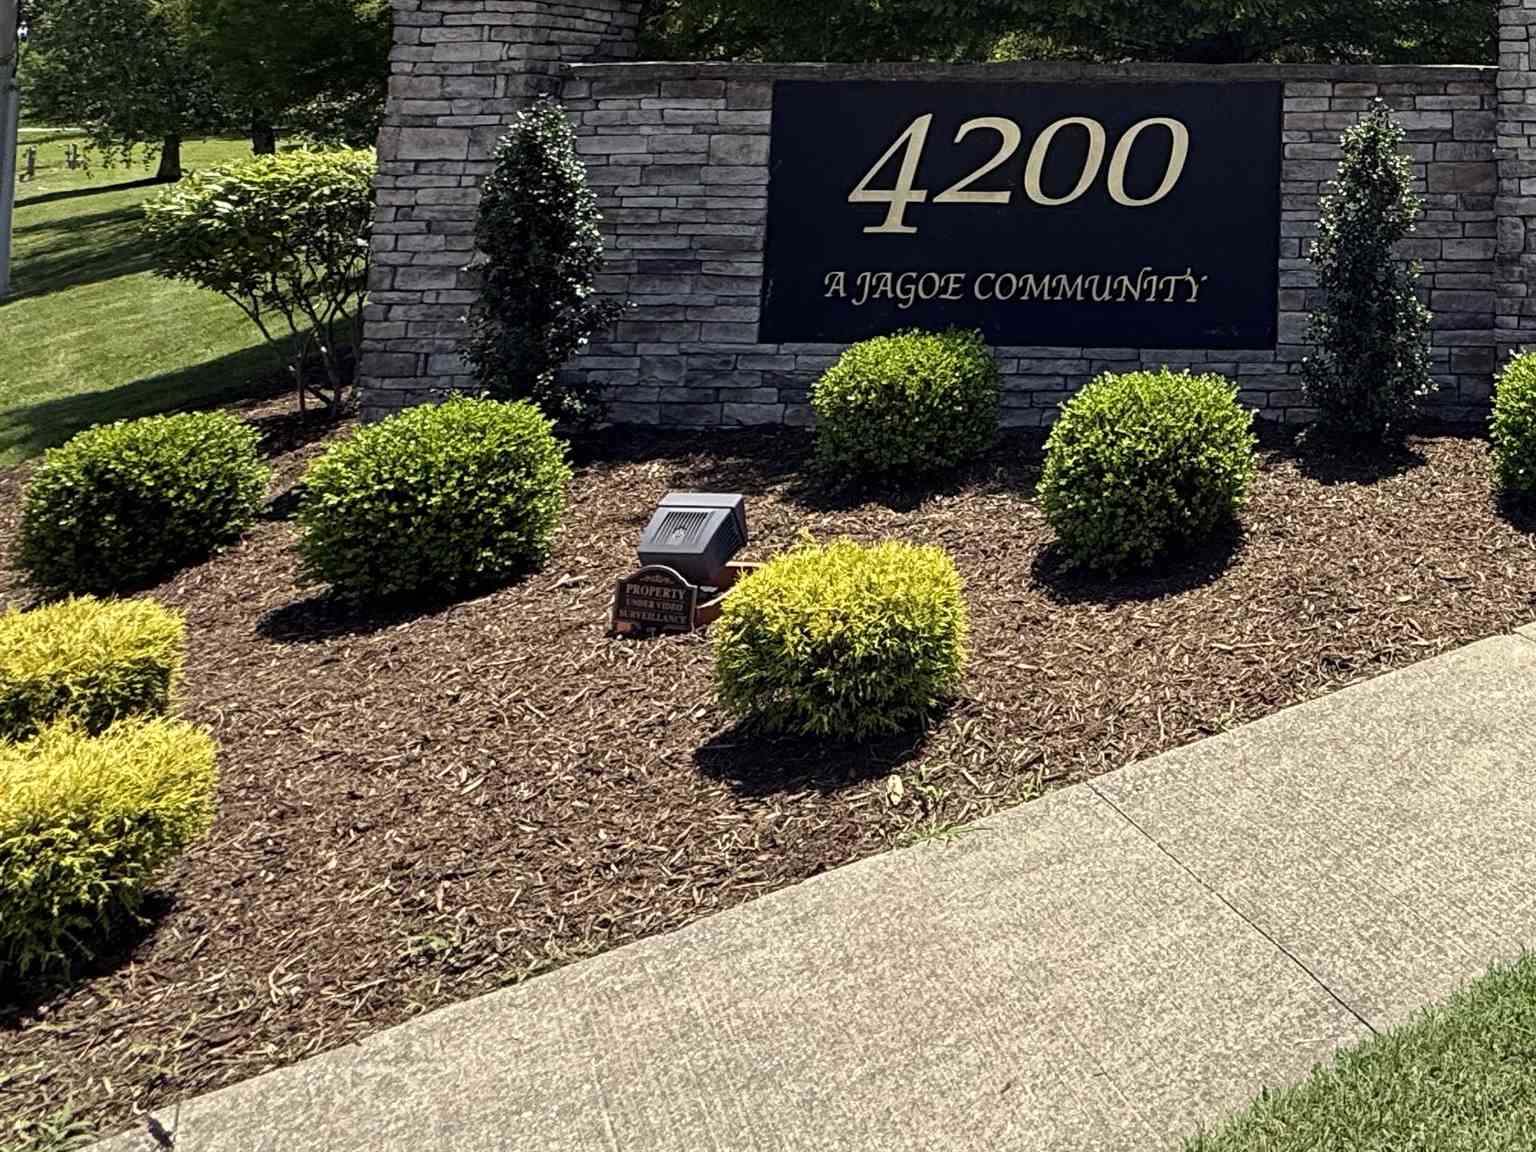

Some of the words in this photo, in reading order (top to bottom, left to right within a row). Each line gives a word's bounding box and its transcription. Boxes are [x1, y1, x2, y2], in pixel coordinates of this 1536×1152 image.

[848, 113, 1190, 233] 4200
[823, 271, 847, 298] A
[851, 271, 965, 309] JAGOE
[974, 267, 1208, 303] COMMUNITY
[626, 583, 687, 600] PROPERTY
[656, 601, 684, 611] VIDEO
